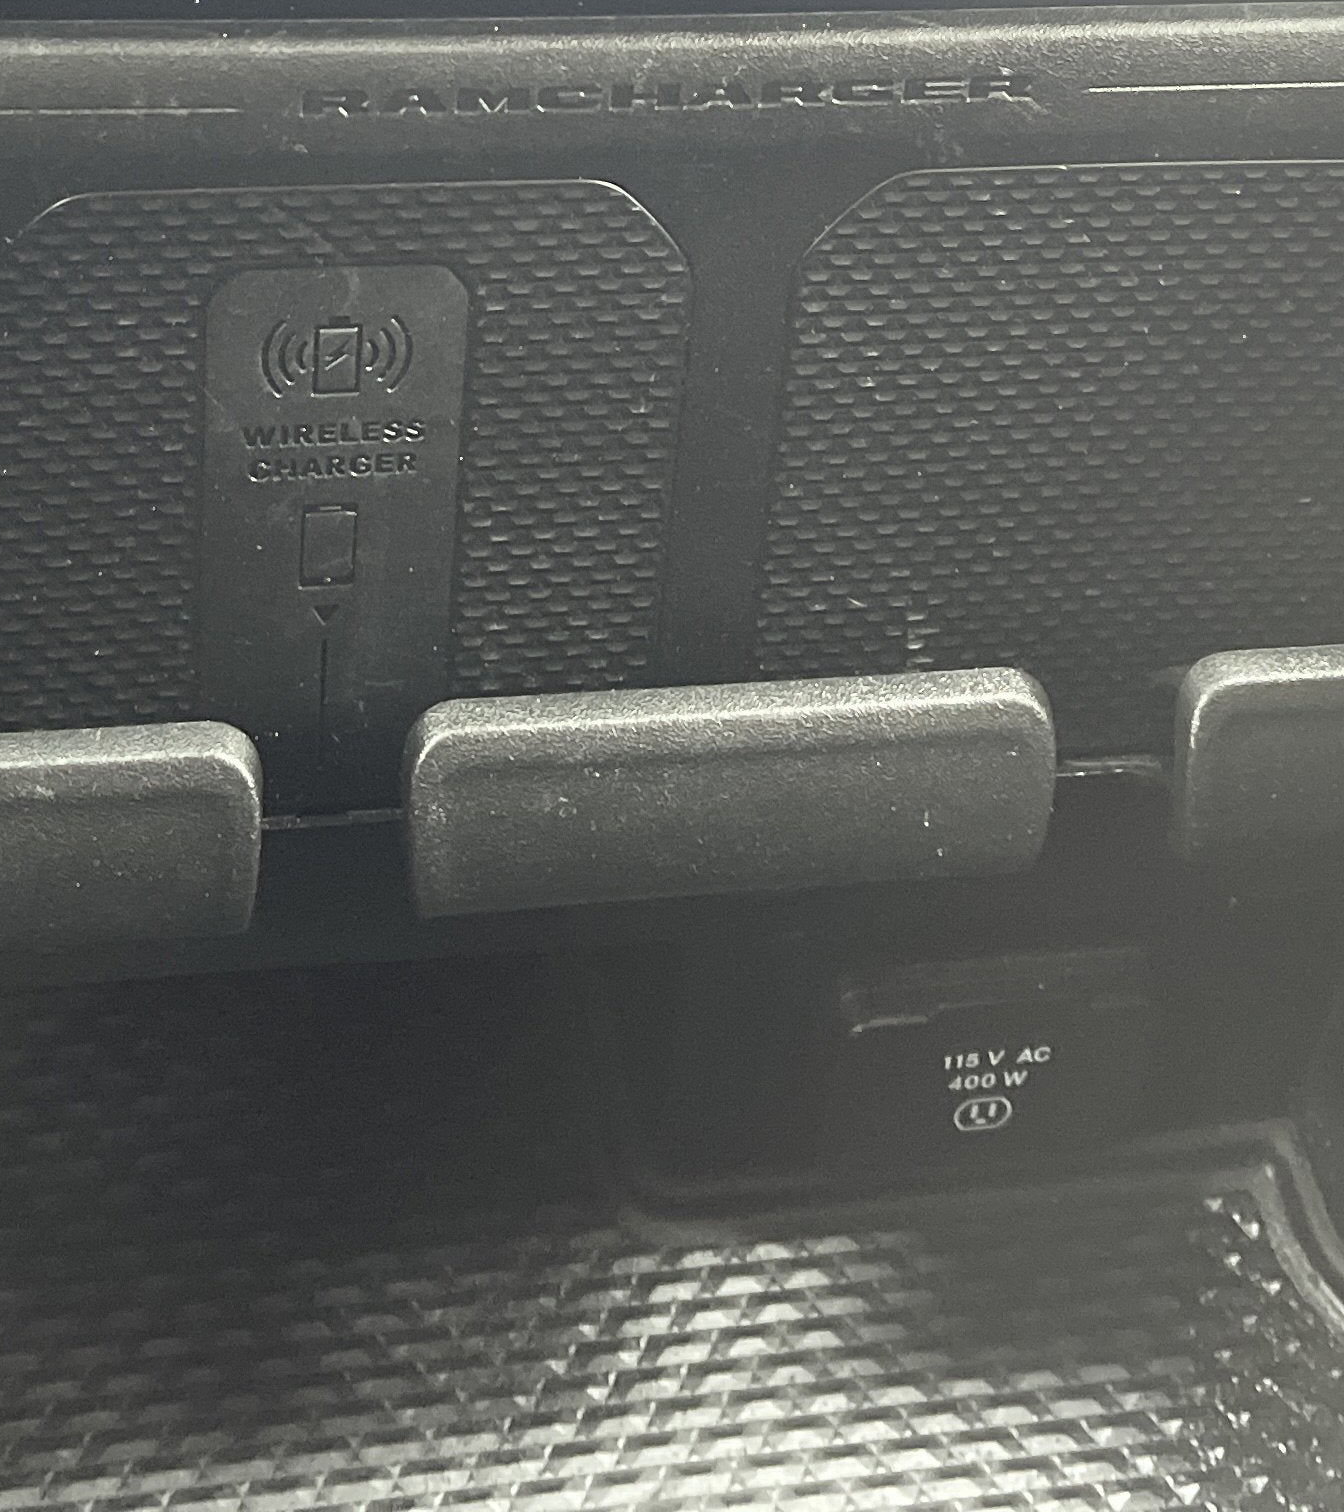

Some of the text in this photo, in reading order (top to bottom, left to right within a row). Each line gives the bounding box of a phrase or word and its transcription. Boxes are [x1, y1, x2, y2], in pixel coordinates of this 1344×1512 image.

[299, 74, 1040, 119] RAMCHARGER
[244, 416, 428, 450] WIRELESS
[247, 451, 420, 483] CHARGER
[944, 1046, 1051, 1070] 115 V AC
[948, 1070, 1028, 1091] 400 W
